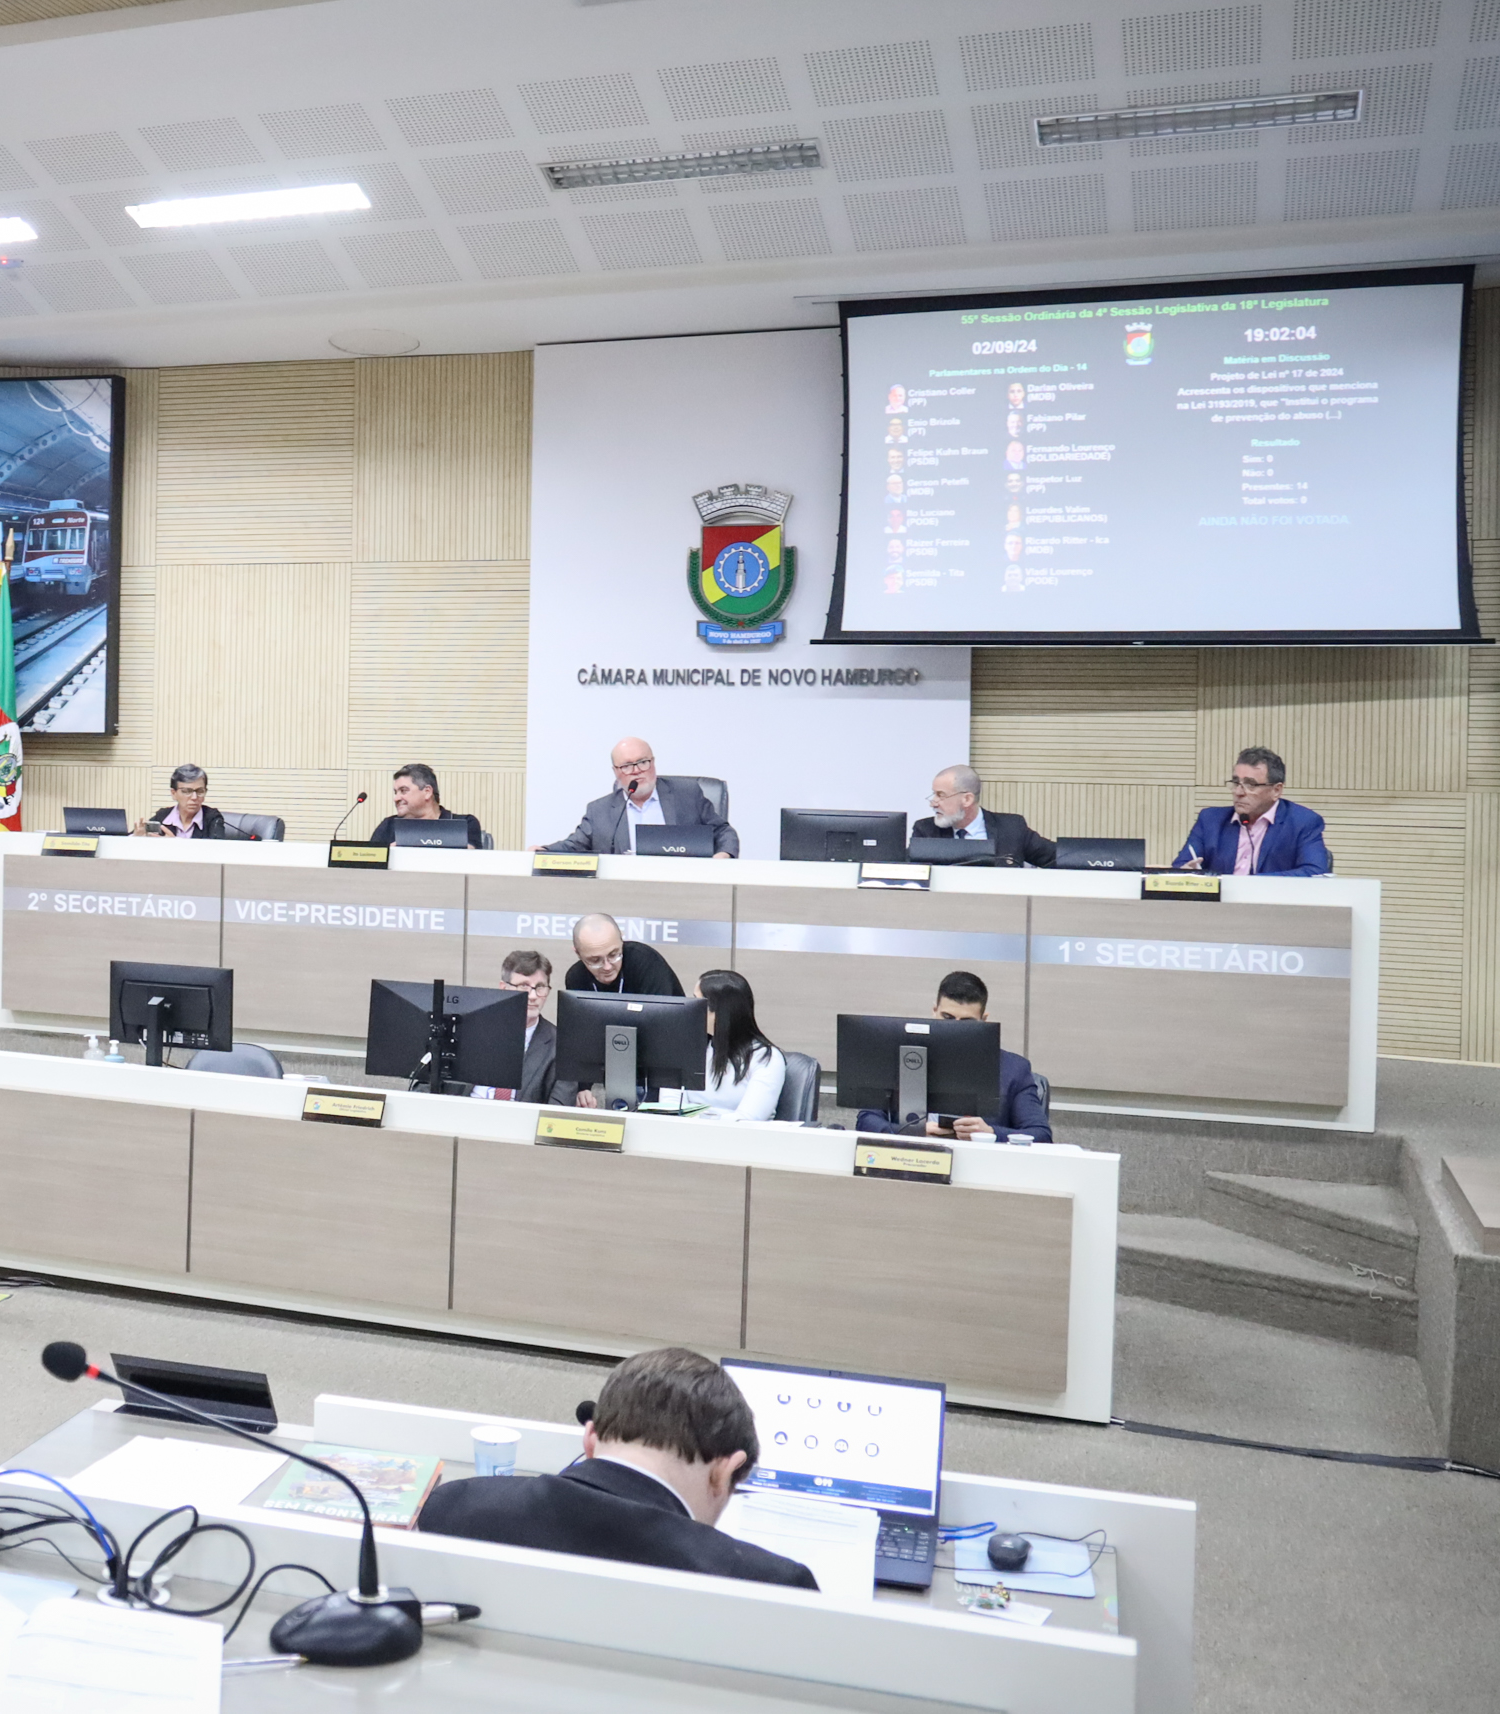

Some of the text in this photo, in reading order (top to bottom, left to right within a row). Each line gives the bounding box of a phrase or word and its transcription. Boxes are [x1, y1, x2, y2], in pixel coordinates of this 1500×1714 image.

[981, 313, 1021, 323] Sessão
[1024, 309, 1075, 321] Ordinária
[1078, 309, 1093, 319] da
[1110, 305, 1152, 317] Sessão
[1155, 301, 1219, 316] Legislativa
[1221, 301, 1236, 312] da
[1261, 297, 1329, 310] Legislatura
[1244, 326, 1316, 342] 19:02:04
[972, 339, 1037, 355] 02/09/24
[1223, 355, 1259, 365] Matéria
[1279, 353, 1331, 363] Discussão
[929, 368, 992, 378] Parlamentares
[1007, 366, 1037, 374] Ordem
[1040, 365, 1051, 373] do
[1053, 364, 1068, 372] Dia
[1076, 363, 1087, 371] 14
[1210, 372, 1245, 382] Projeto
[1247, 372, 1259, 380] de
[1261, 371, 1278, 379] Lei
[1292, 370, 1303, 378] 17
[1319, 368, 1344, 376] 2024
[1059, 382, 1094, 391] Oliveira
[1177, 387, 1231, 396] Acrescenta
[1247, 384, 1306, 394] dispositivos
[1309, 385, 1327, 393] que
[1329, 382, 1379, 390] menciona
[908, 387, 976, 397] Cristiano Coller
[1027, 392, 1055, 402] (MDB)
[908, 398, 927, 407] (PP)
[1260, 400, 1278, 409] que
[1330, 396, 1379, 406] programa
[908, 418, 961, 427] Enio Brizola
[1027, 414, 1063, 422] Fabiano
[1211, 414, 1223, 423] de
[1225, 412, 1276, 423] prevenção
[1278, 412, 1291, 420] do
[1293, 412, 1323, 420] abuso
[908, 428, 926, 436] (PT)
[1027, 423, 1046, 432] (PP)
[1027, 443, 1116, 453] Fernando Lourenço
[1251, 439, 1301, 447] Resultado
[908, 447, 988, 458] Felipe Kuhn Braun
[1027, 452, 1111, 463] (SOLIDARIEDADE)
[908, 457, 939, 467] (PSDB)
[1242, 455, 1274, 463] Sim: 0
[1242, 469, 1274, 477] Não: 0
[907, 479, 938, 487] Gerson
[1027, 476, 1062, 485] Inspetor
[1027, 484, 1046, 494] (PP)
[1242, 482, 1308, 491] Presentes: 14
[907, 487, 934, 497] (MDB)
[1242, 496, 1307, 505] Total votos: 0
[1027, 506, 1062, 514] Lourdes
[907, 517, 939, 527] (PODE)
[1027, 514, 1108, 525] (REPUBLICANOS)
[1199, 517, 1237, 526] AINDA
[1241, 514, 1268, 526] NÃO
[1272, 517, 1292, 525] FOI
[936, 538, 970, 546] Ferreira
[1026, 537, 1059, 545] Ricardo
[1026, 546, 1053, 555] (MDB)
[1050, 568, 1093, 576] Lourenço
[578, 664, 920, 686] CÂMARA MUNICIPAL DE NOVO HAMBURGO
[54, 894, 197, 920] SECRETÁRIO
[235, 900, 445, 931] VICE-PRESIDENTE
[1095, 942, 1304, 974] SECRETÁRIO
[447, 996, 459, 1004] LG
[263, 1500, 300, 1510] SEM
